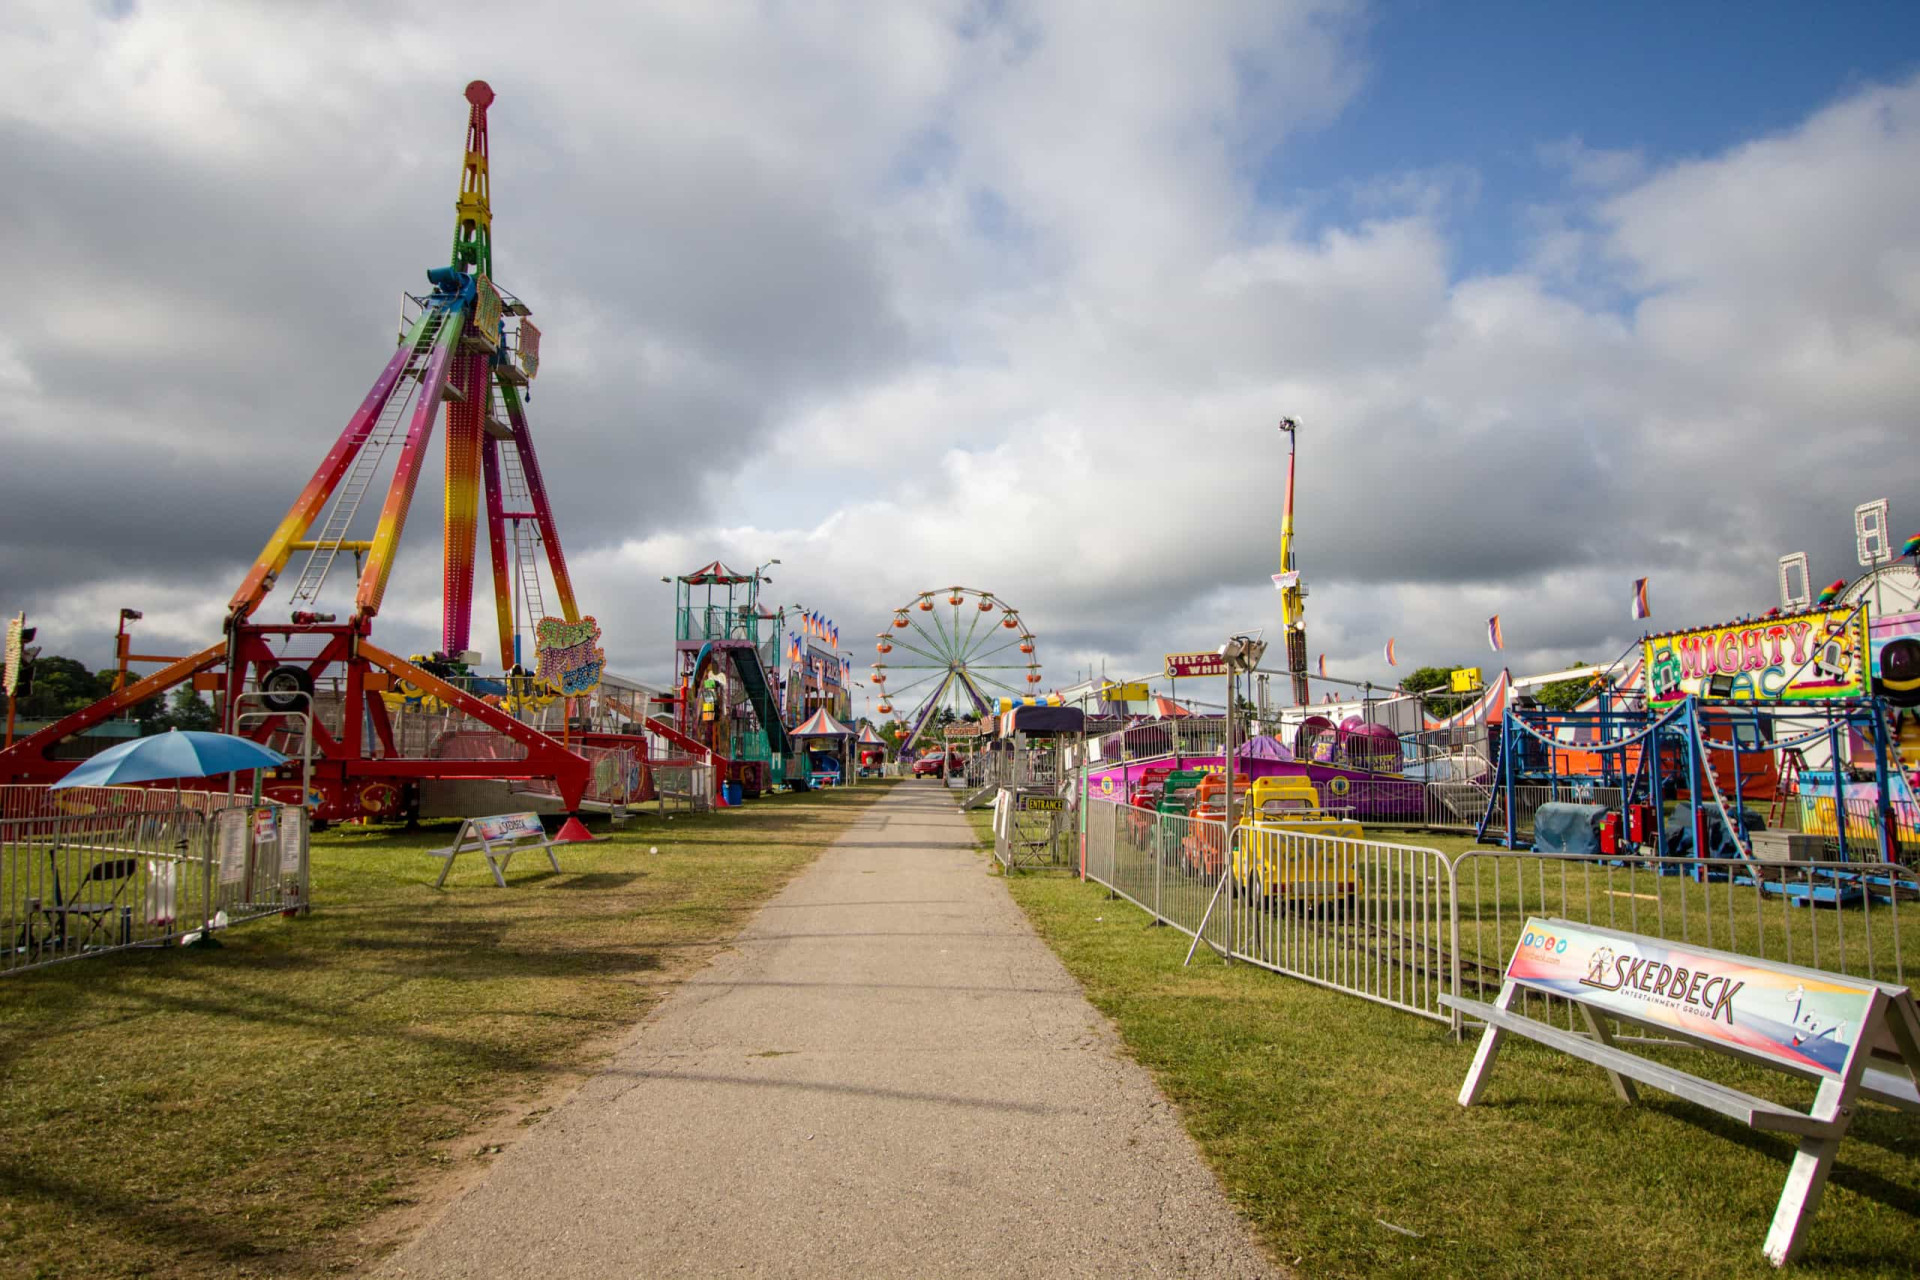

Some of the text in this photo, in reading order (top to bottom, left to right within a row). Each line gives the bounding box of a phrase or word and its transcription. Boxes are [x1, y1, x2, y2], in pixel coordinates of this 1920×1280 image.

[1680, 621, 1812, 679] MIGHTY
[1029, 800, 1063, 810] ENTRANCE
[1579, 955, 1745, 1025] SKERBECK
[1620, 988, 1712, 1018] ENTERTAINMENT GROUP
